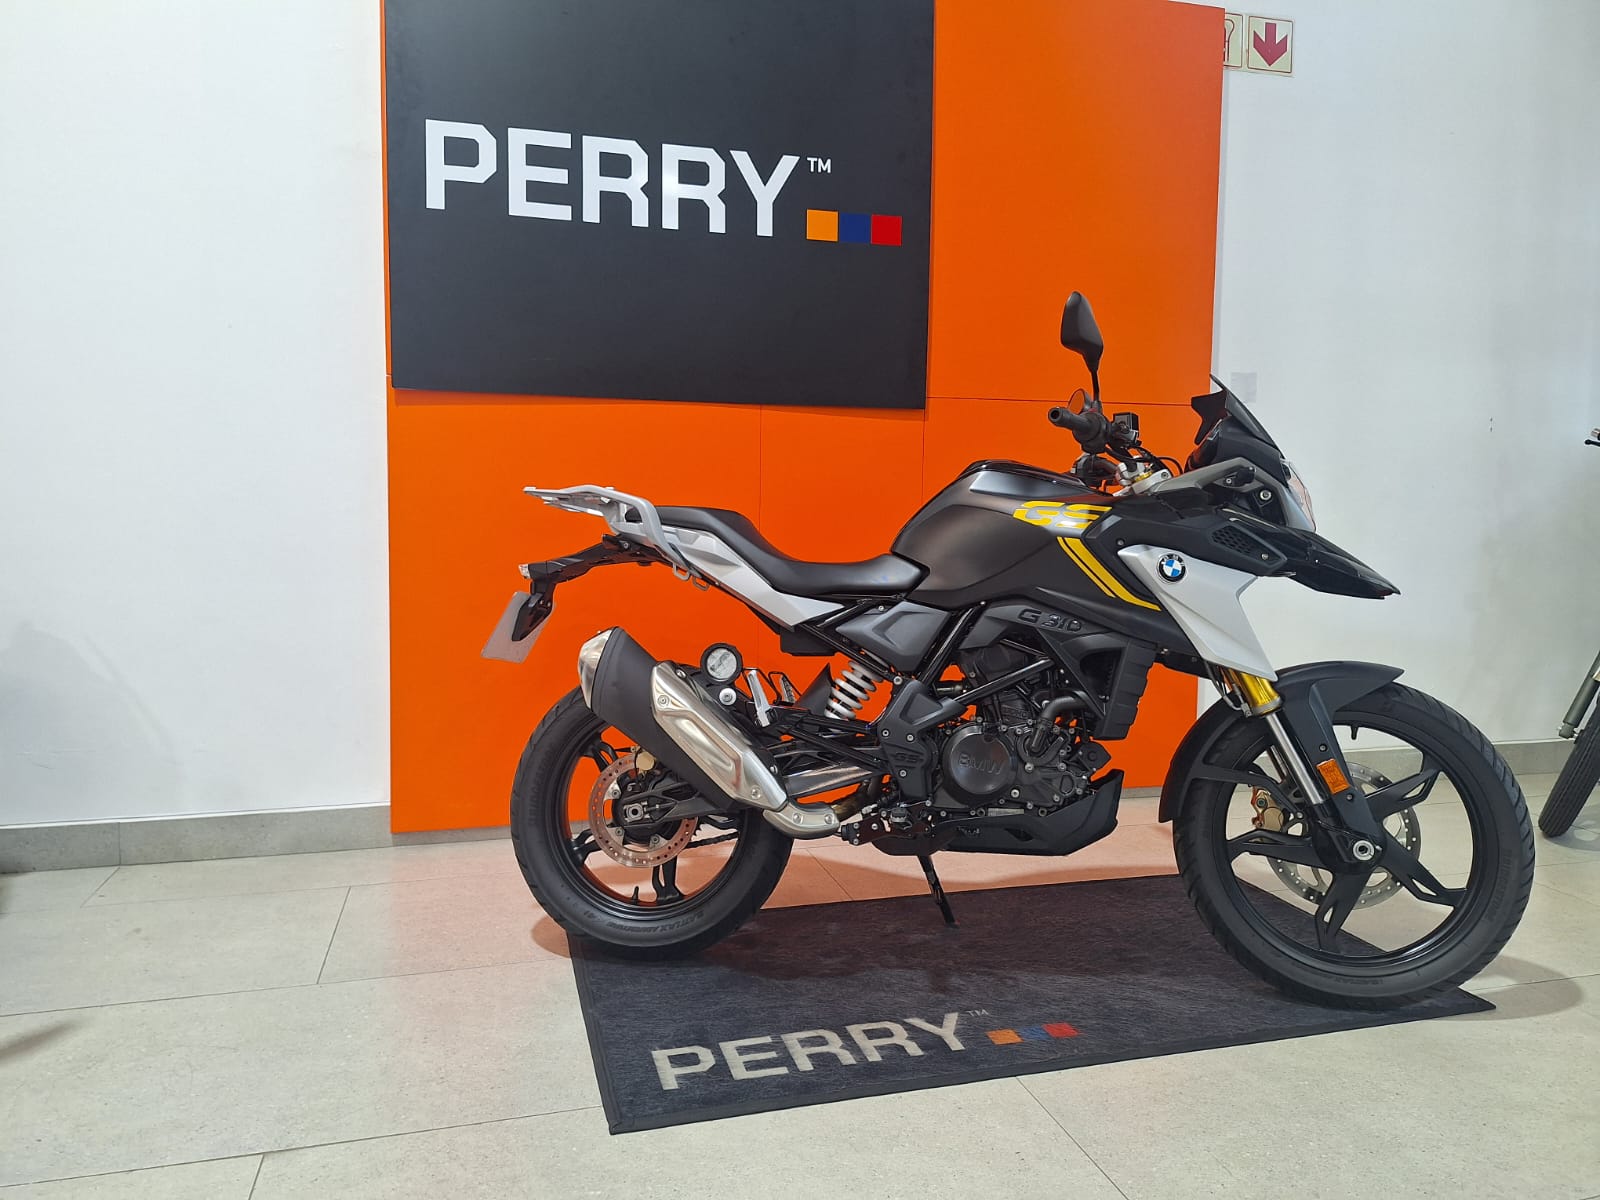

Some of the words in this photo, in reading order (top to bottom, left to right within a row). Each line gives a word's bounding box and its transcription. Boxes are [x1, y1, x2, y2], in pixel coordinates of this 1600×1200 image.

[425, 118, 800, 237] PERRY
[1013, 501, 1112, 529] GS
[1017, 608, 1042, 623] G
[1042, 613, 1082, 631] 310
[959, 752, 1004, 776] BMW
[651, 1012, 966, 1090] PERRY
